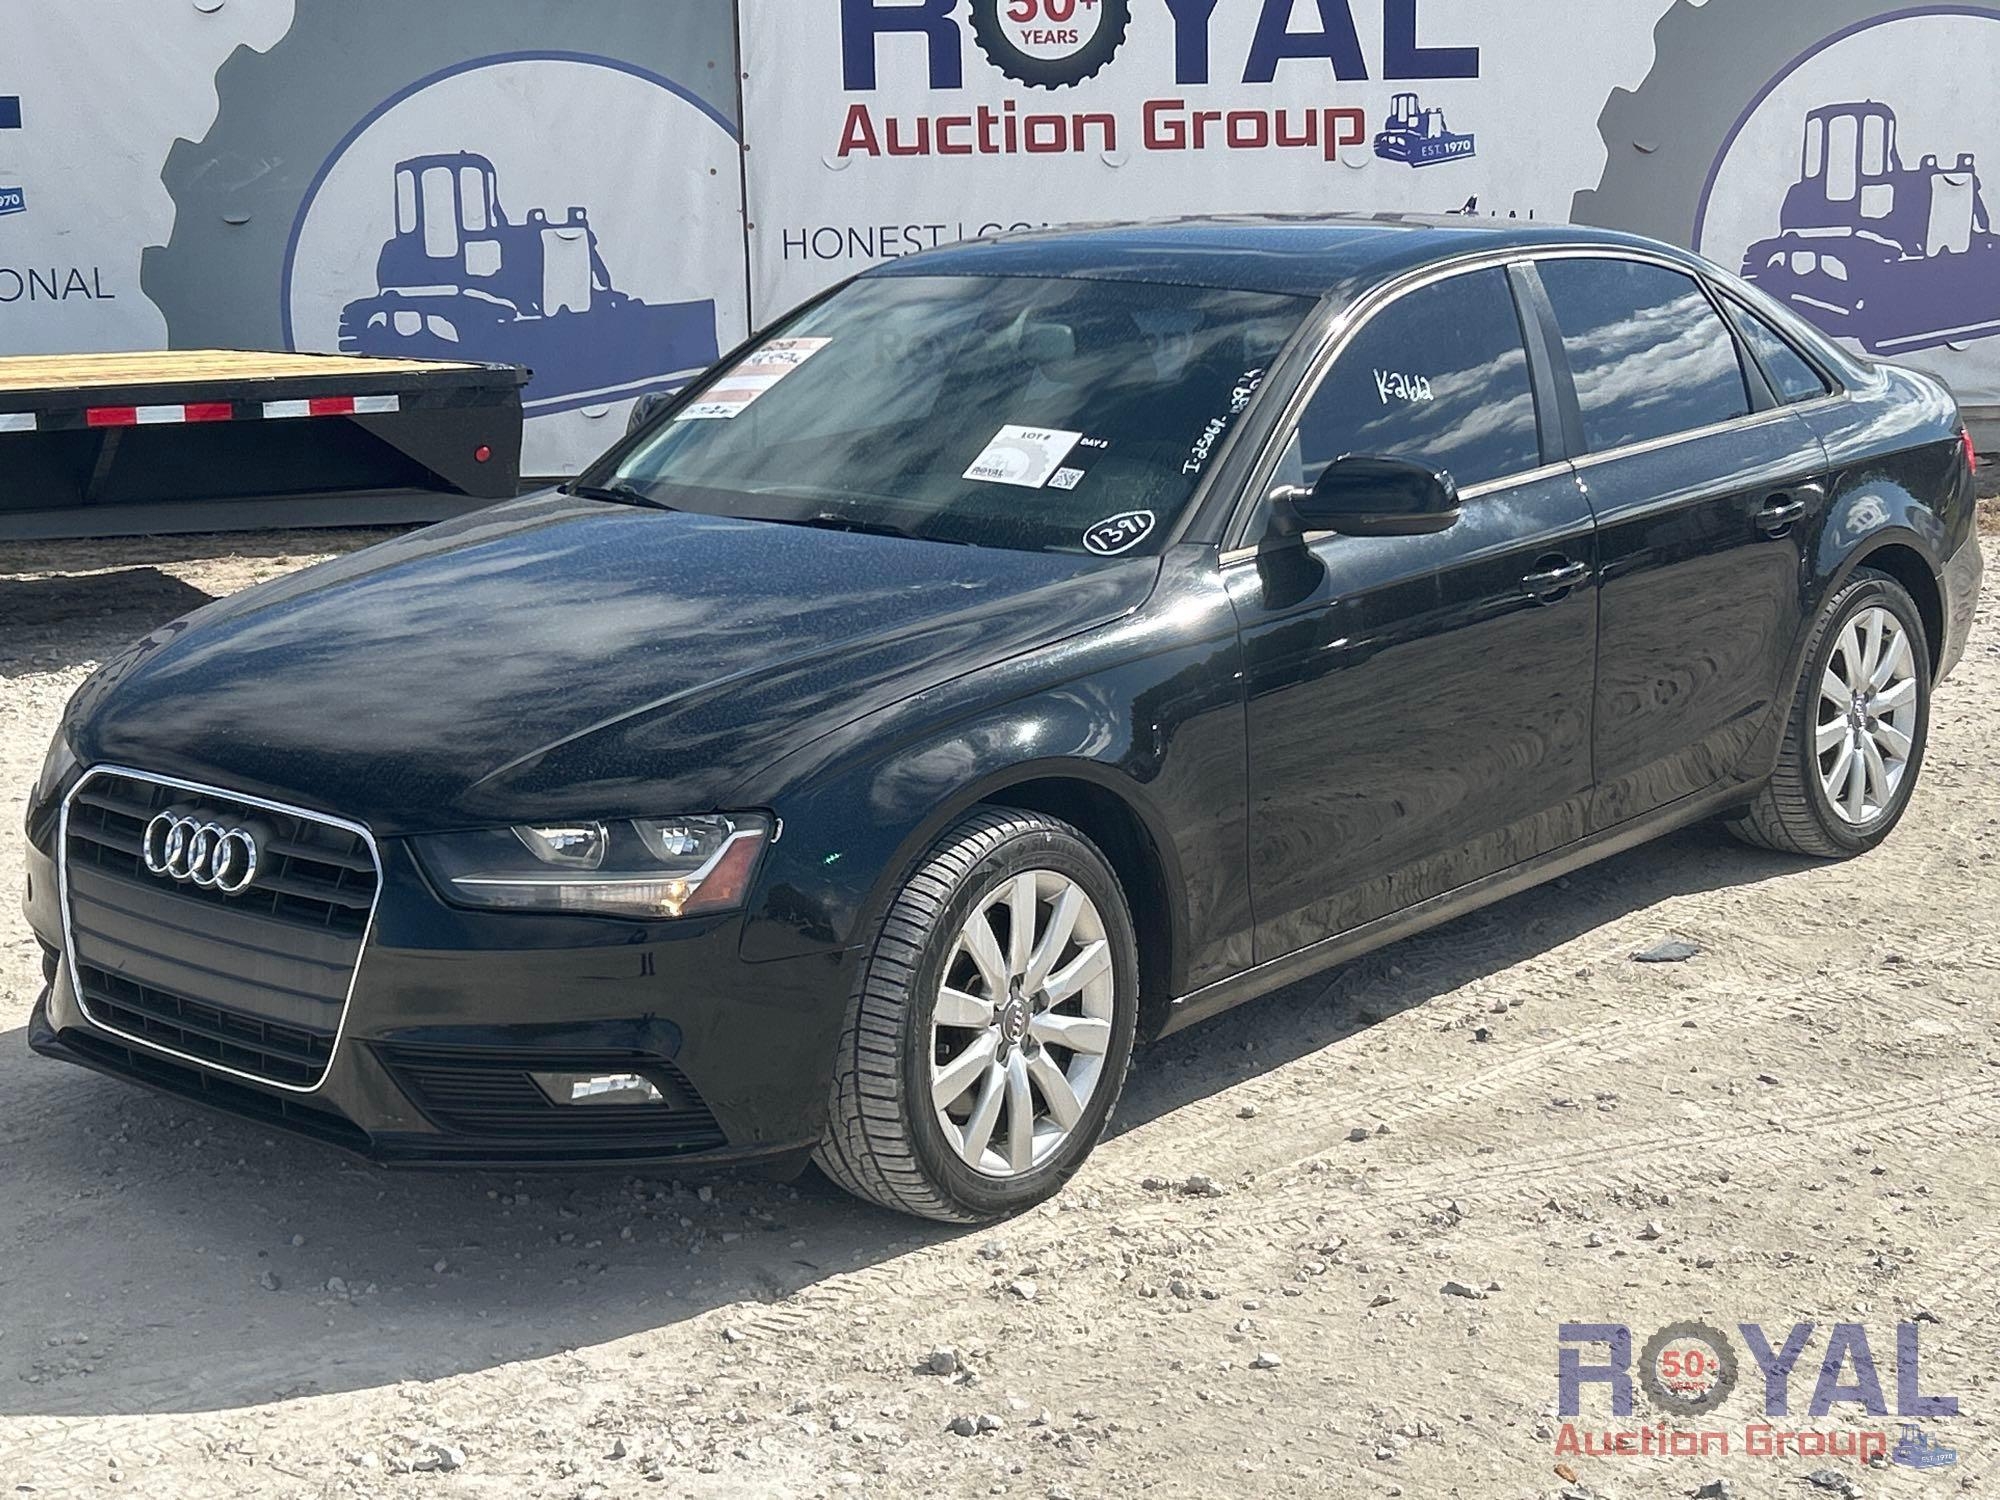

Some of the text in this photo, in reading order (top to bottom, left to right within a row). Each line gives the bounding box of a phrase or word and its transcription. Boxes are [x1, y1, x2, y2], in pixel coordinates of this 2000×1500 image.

[1021, 30, 1078, 44] YEARS
[837, 99, 1366, 161] Auction Group
[1444, 140, 1471, 153] 1970
[783, 225, 946, 260] HONEST
[1089, 515, 1146, 551] 1391
